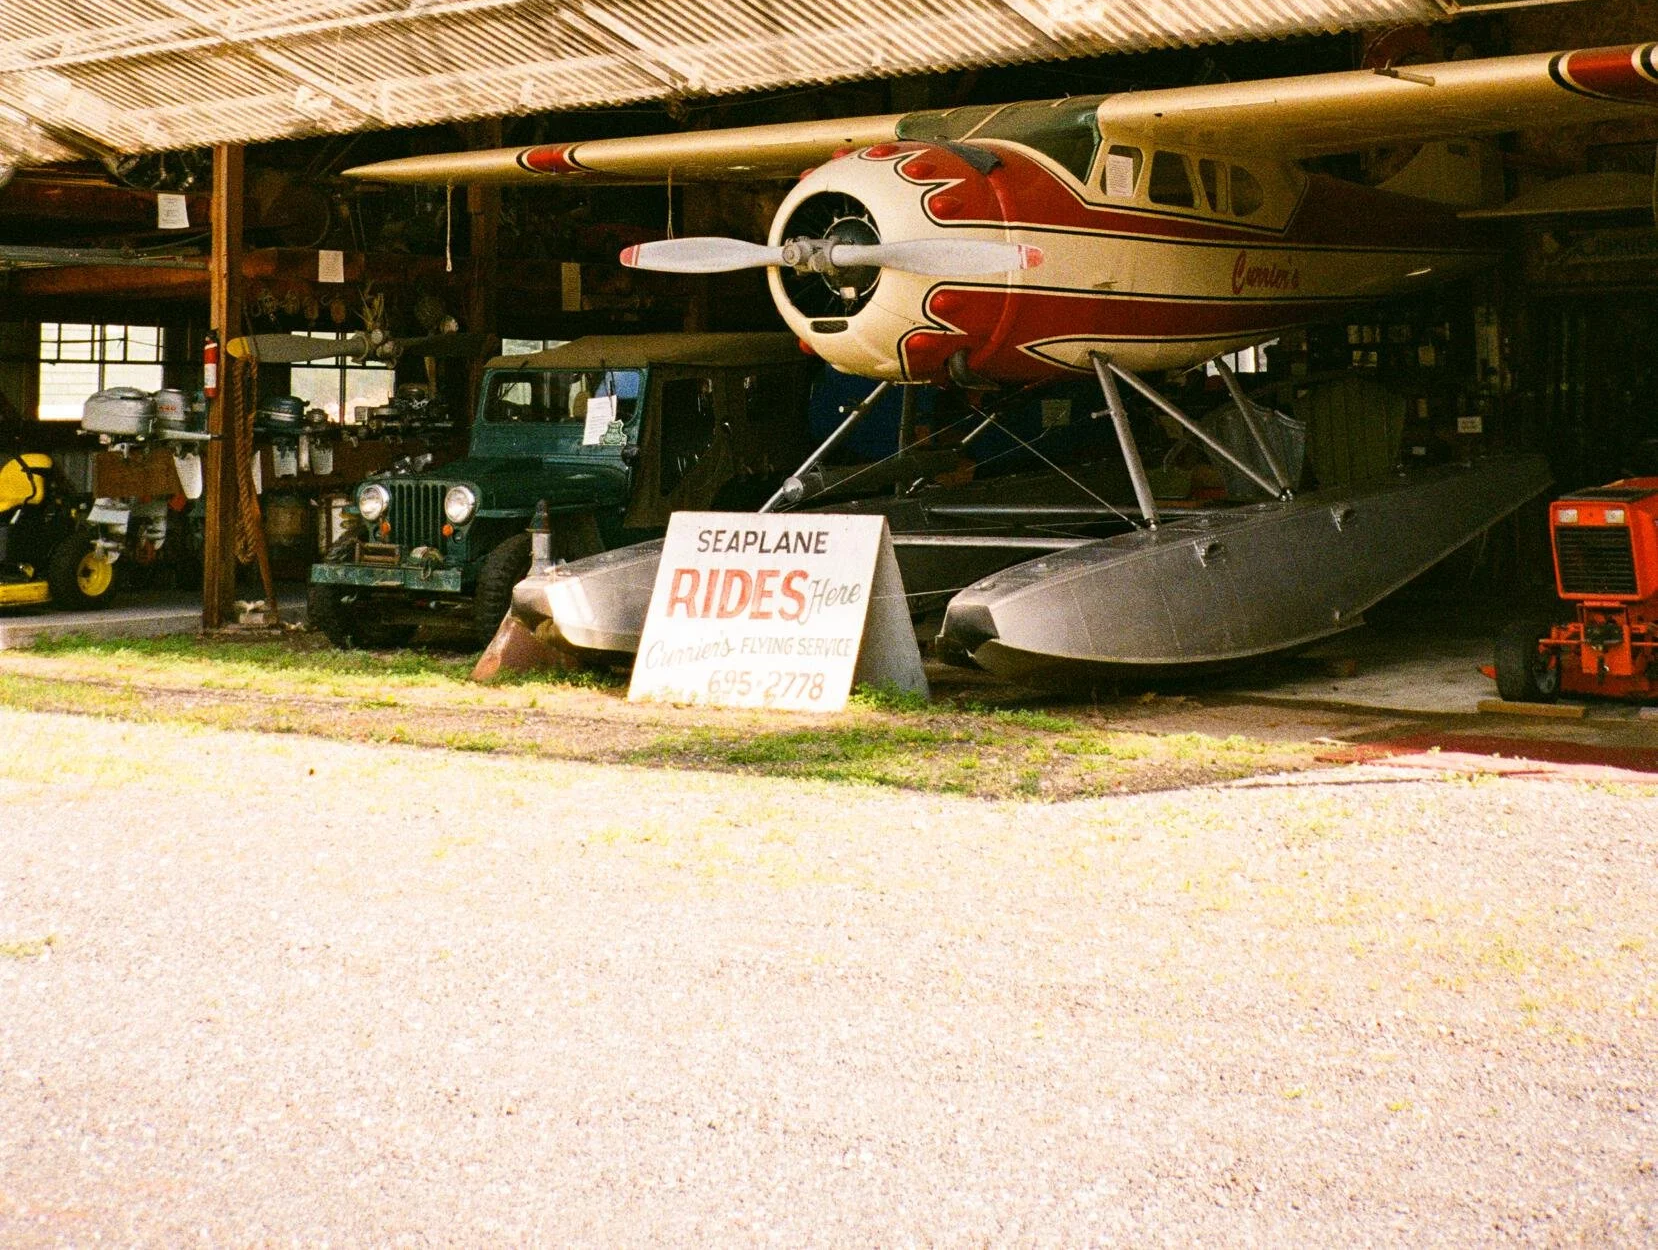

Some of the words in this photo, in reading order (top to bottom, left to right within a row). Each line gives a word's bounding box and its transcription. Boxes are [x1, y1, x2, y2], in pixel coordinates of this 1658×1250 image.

[696, 529, 829, 555] SEAPLANE
[665, 567, 810, 621] RIDES
[797, 578, 862, 626] Here
[645, 630, 737, 669] Currier's
[740, 636, 796, 656] FLYING
[797, 637, 853, 658] SERVICE
